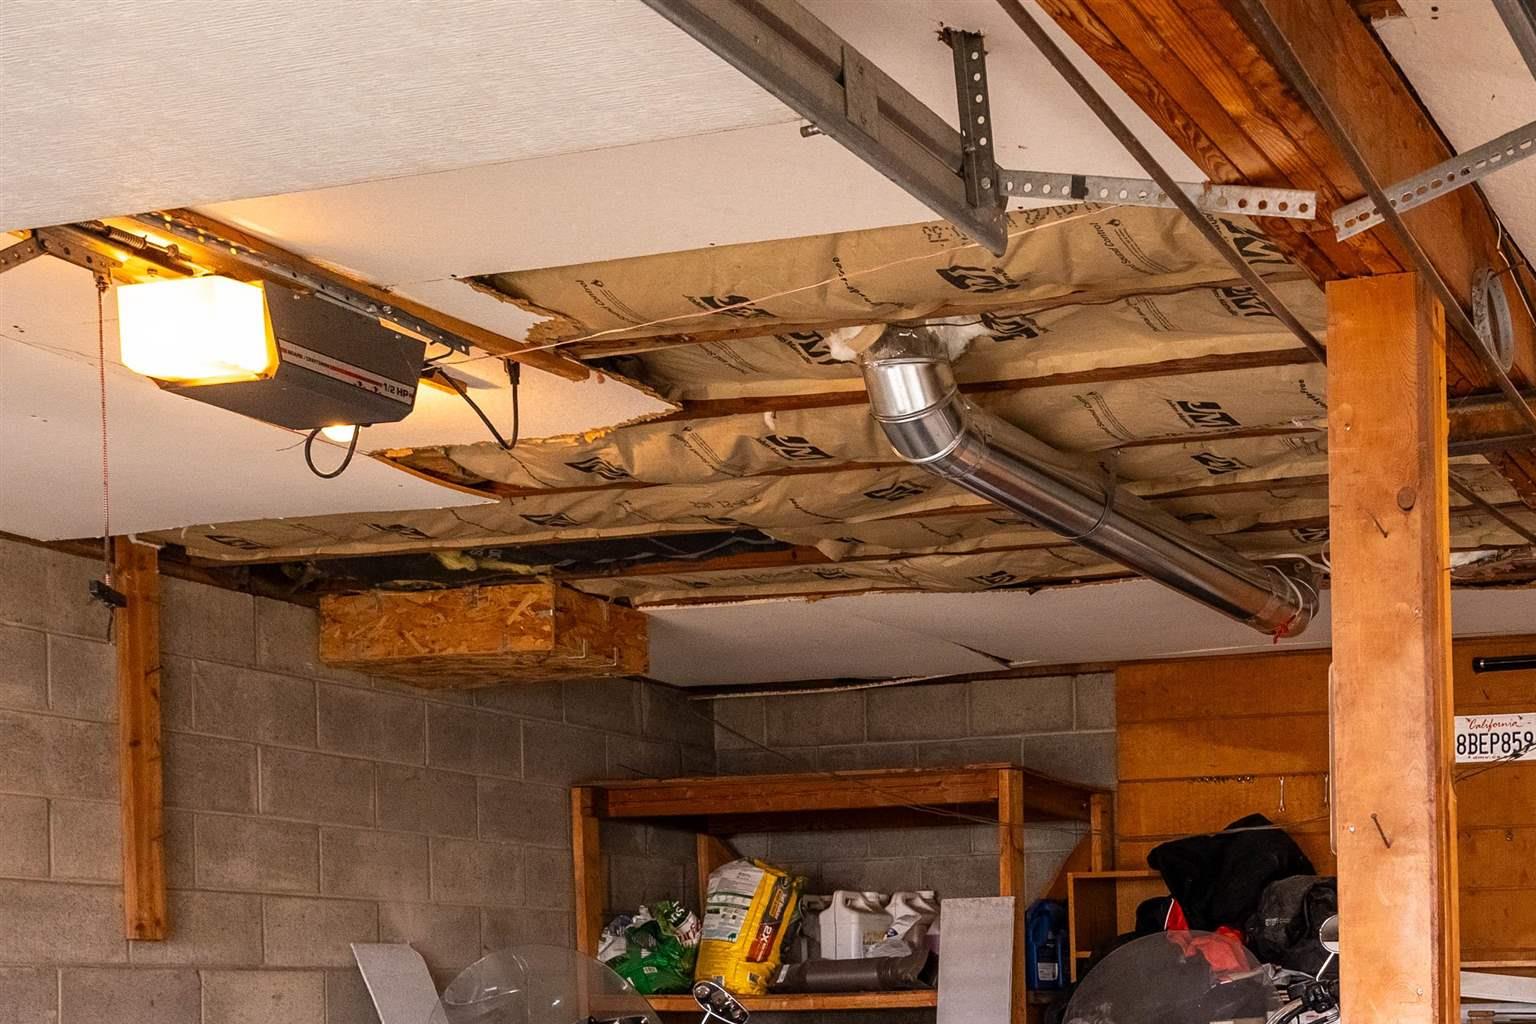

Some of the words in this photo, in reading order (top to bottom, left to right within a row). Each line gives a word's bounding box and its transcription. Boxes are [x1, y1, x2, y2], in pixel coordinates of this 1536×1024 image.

[384, 383, 395, 393] 1/2
[396, 387, 409, 398] HP
[1469, 719, 1519, 731] California
[1456, 731, 1534, 755] 8BEP859
